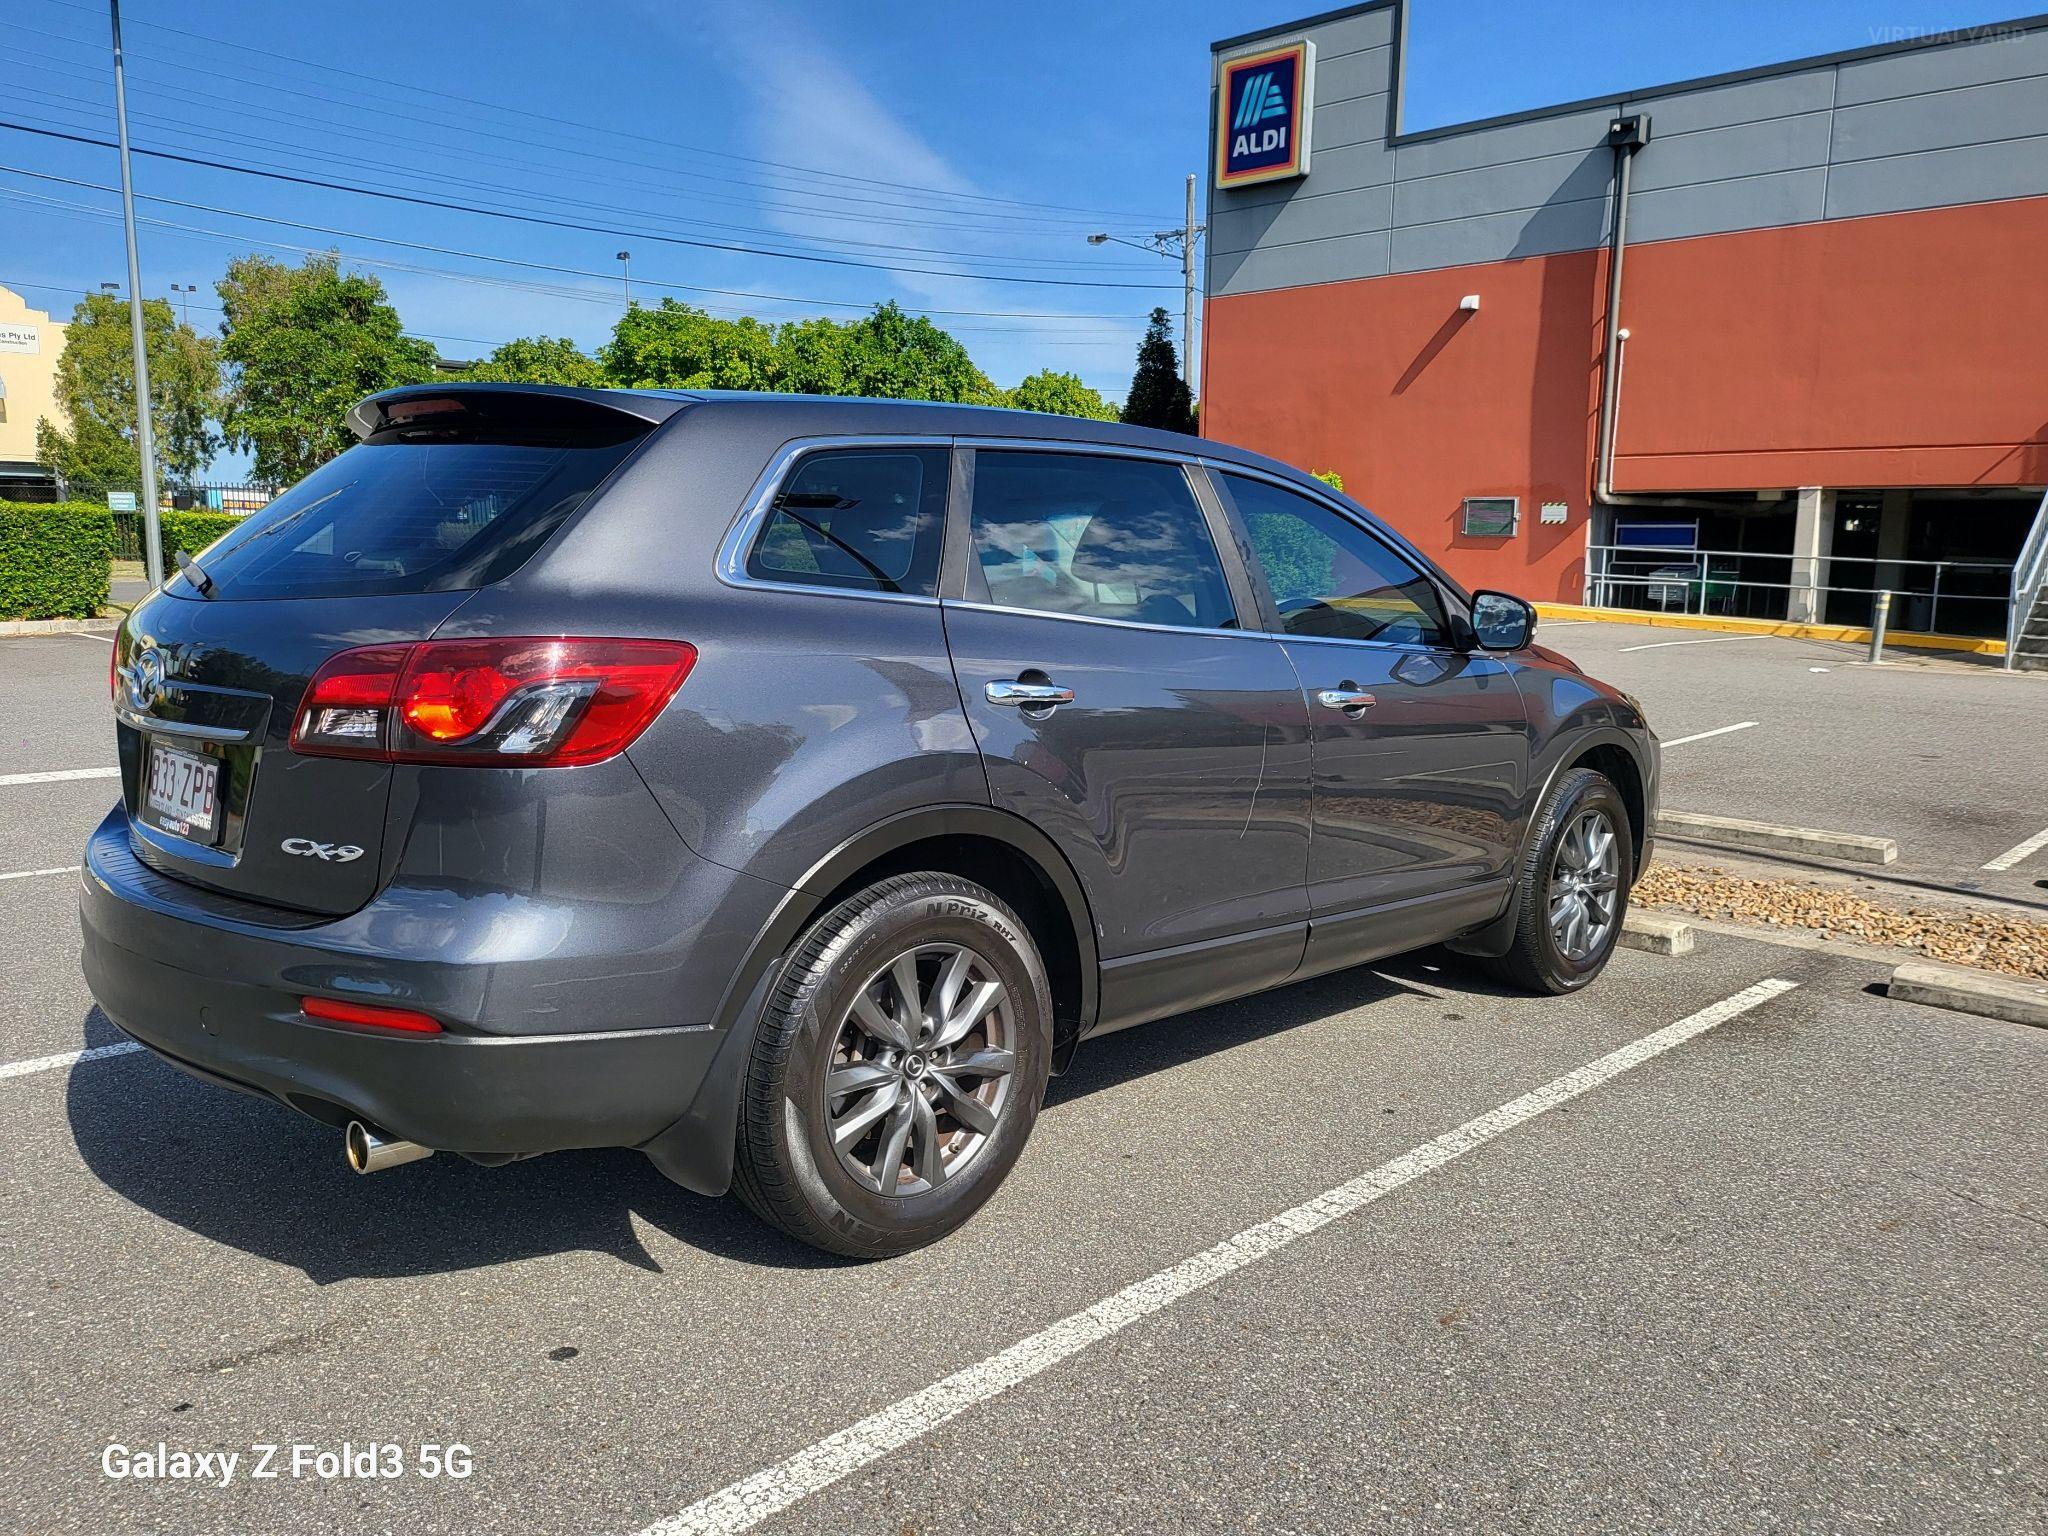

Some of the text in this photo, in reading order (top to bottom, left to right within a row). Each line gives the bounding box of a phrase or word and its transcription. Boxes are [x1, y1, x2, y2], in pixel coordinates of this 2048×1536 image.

[1232, 126, 1286, 157] ALDI
[9, 332, 21, 340] Pty
[151, 755, 176, 801] 833
